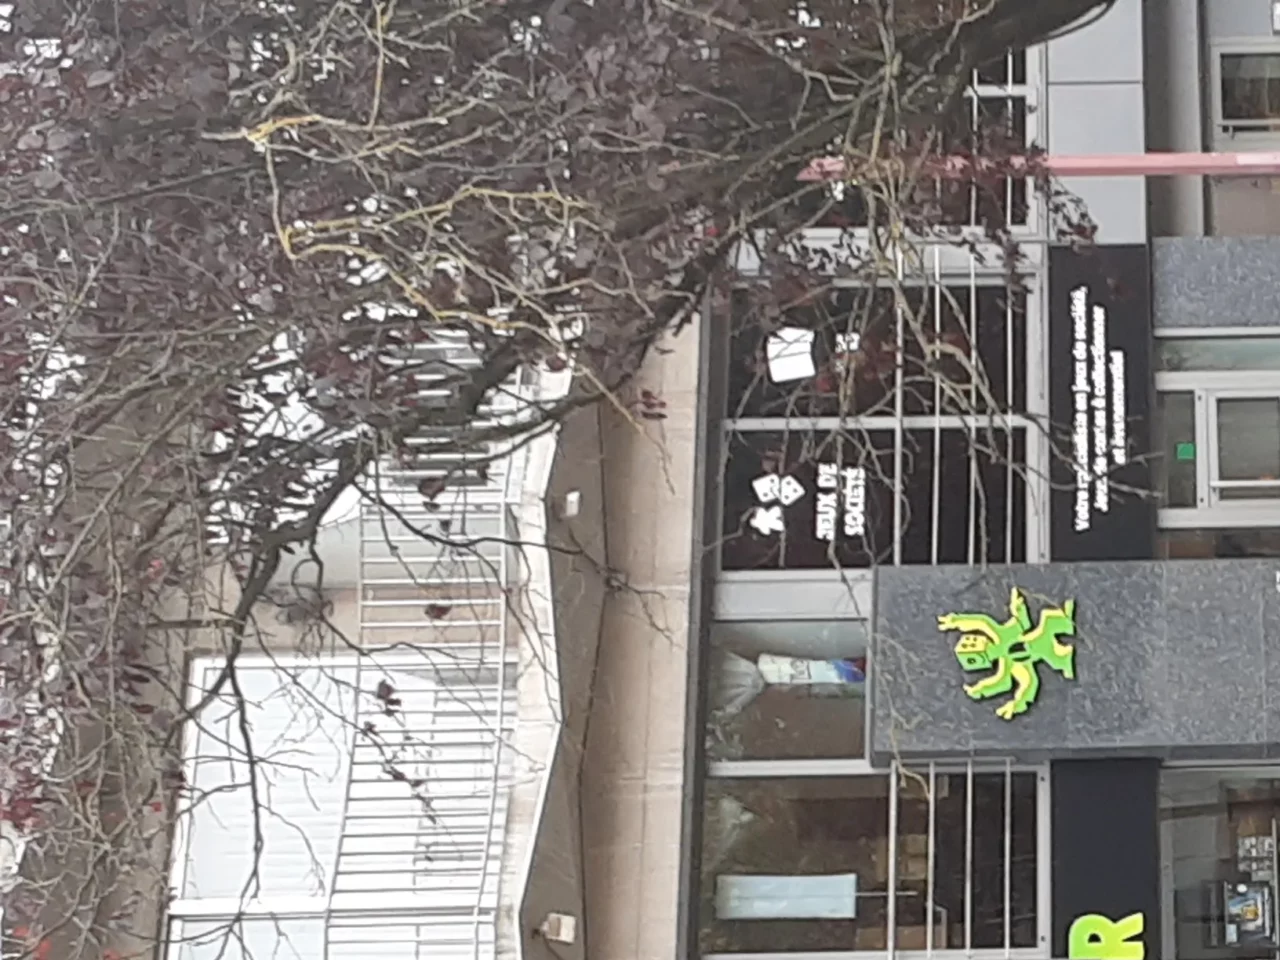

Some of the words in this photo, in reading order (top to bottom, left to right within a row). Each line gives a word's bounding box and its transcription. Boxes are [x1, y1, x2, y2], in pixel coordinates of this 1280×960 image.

[1072, 341, 1088, 360] de
[1090, 305, 1106, 396] collectionner
[1071, 361, 1092, 392] jeux
[1075, 392, 1088, 412] en
[1090, 398, 1106, 408] à
[1111, 448, 1126, 464] et
[816, 462, 838, 488] DE
[815, 492, 837, 540] JEUX
[1074, 490, 1090, 531] Votre
